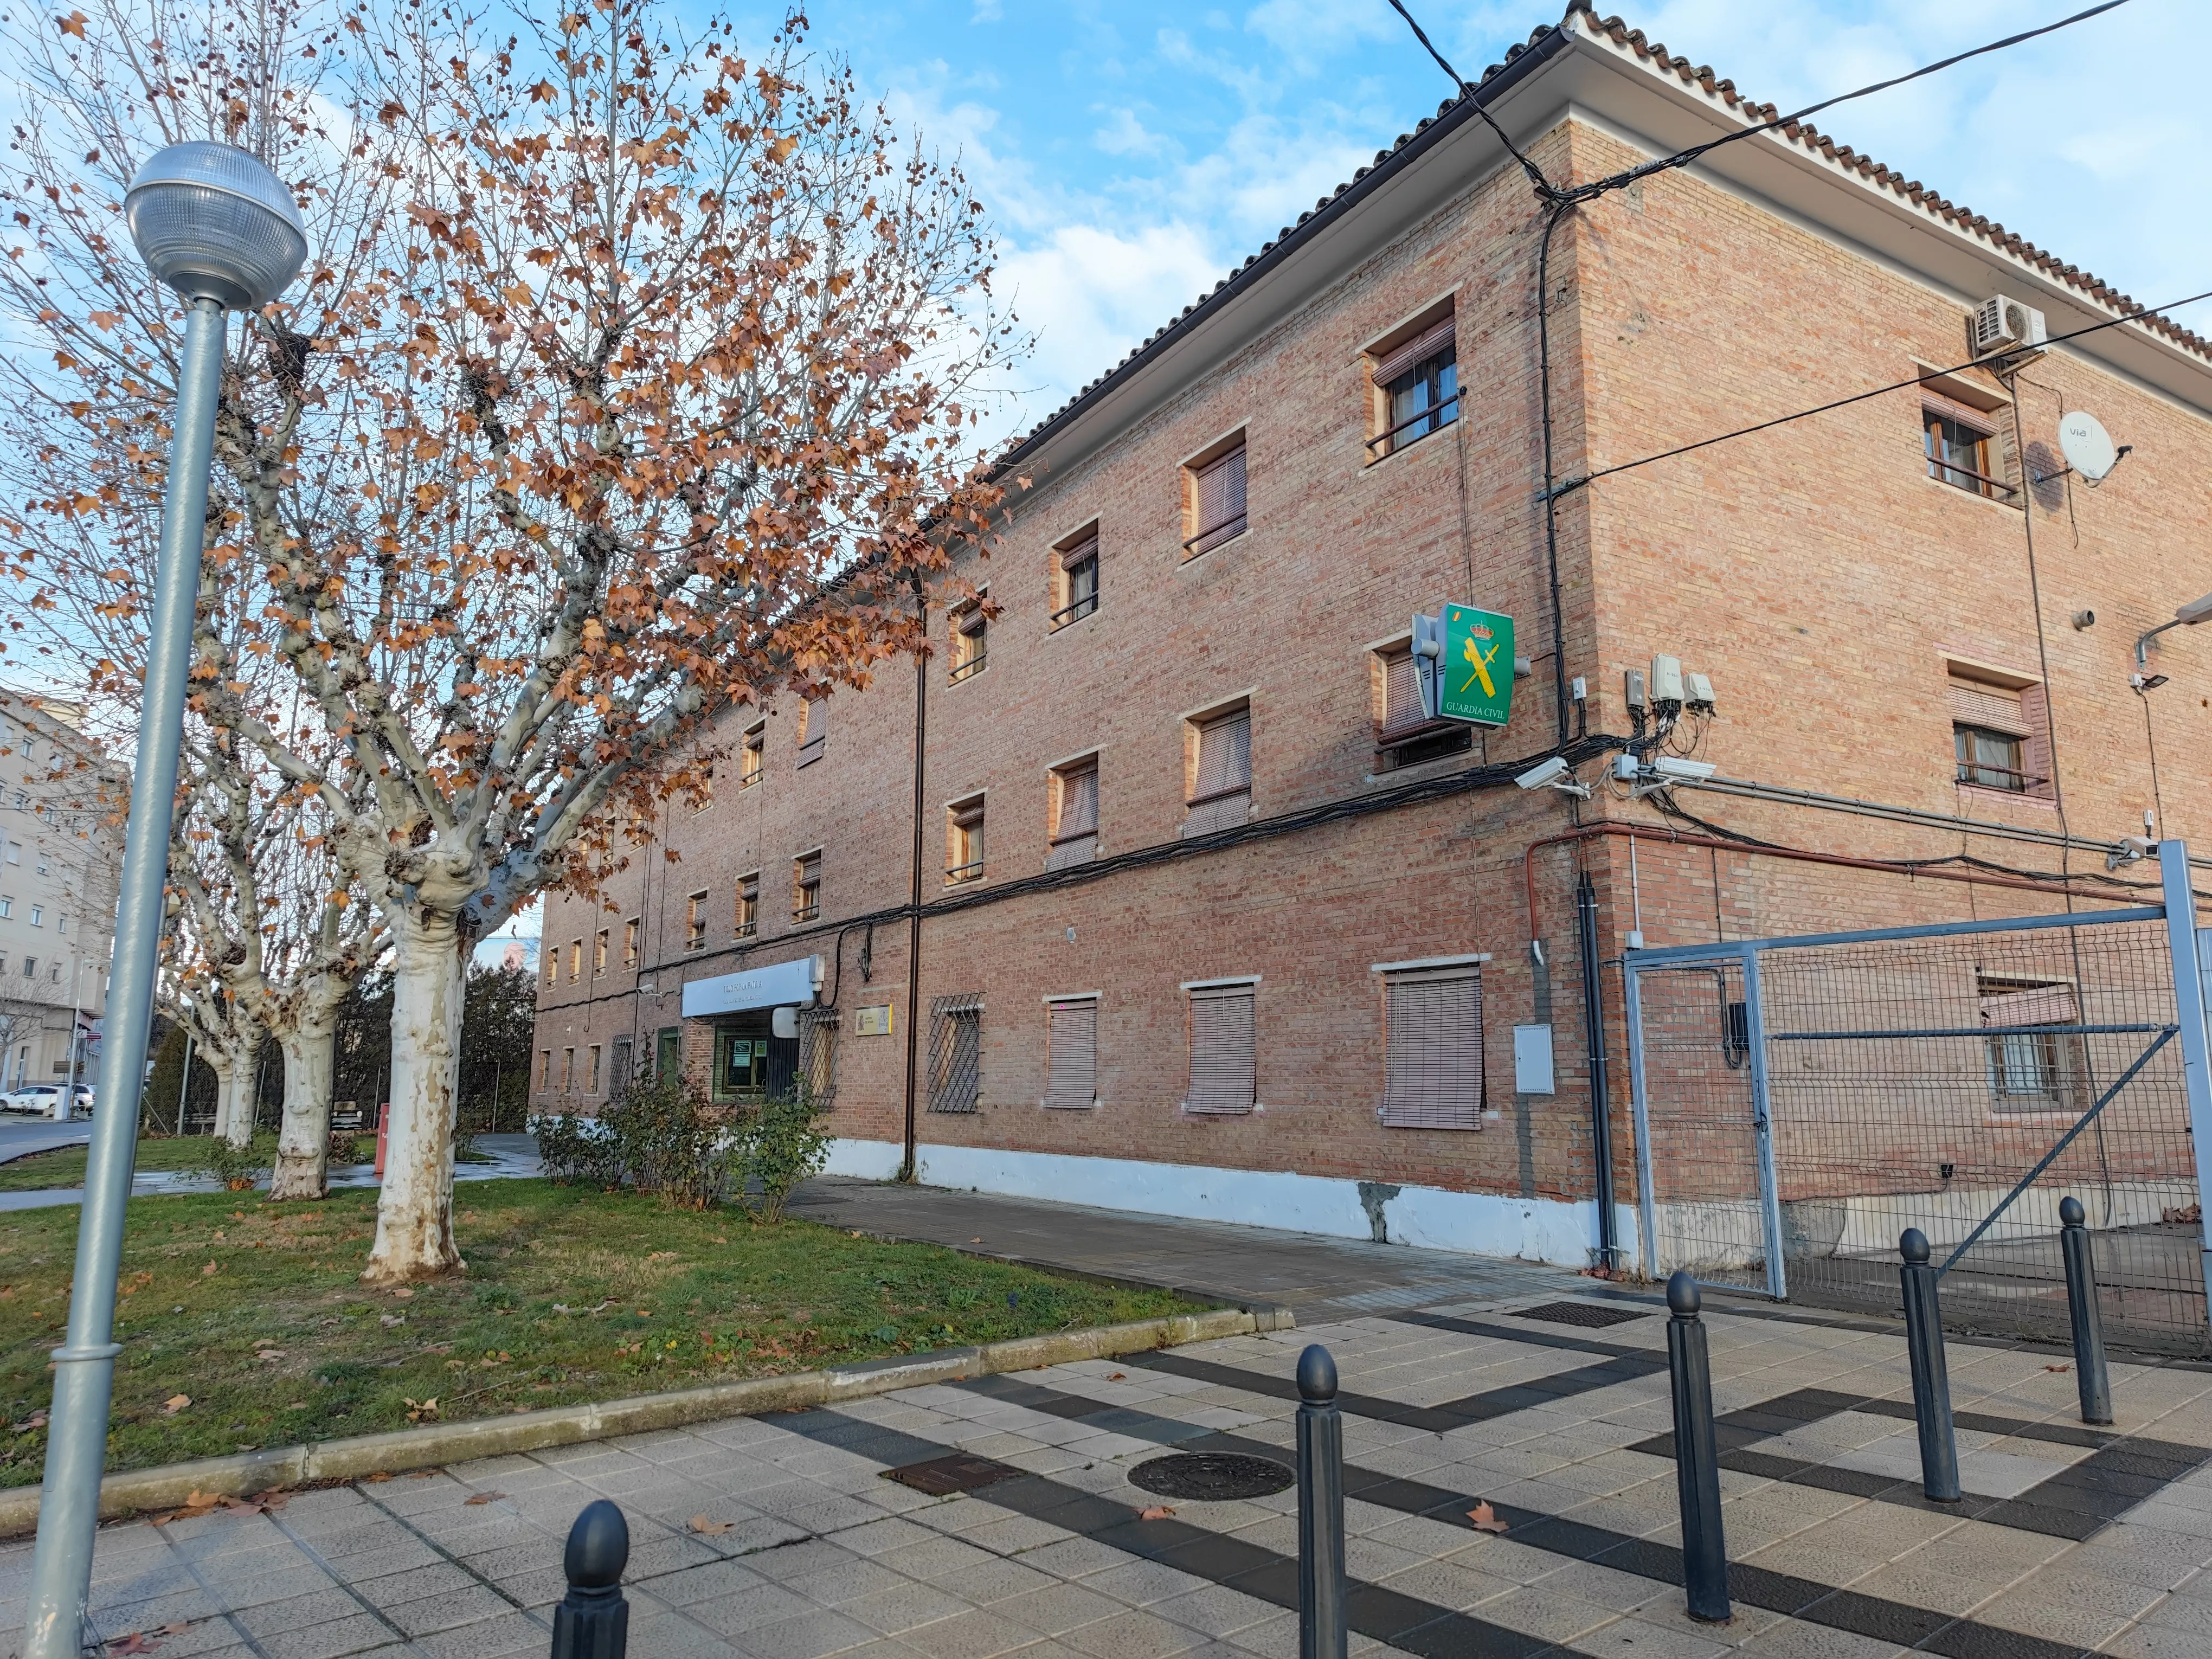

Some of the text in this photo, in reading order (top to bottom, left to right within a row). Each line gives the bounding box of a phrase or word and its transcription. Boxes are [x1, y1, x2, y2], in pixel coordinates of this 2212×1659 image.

[1446, 702, 1505, 719] GUARDIA CIVIL
[724, 985, 734, 993] TODO
[734, 983, 742, 992] POR
[748, 980, 762, 989] PATRIA
